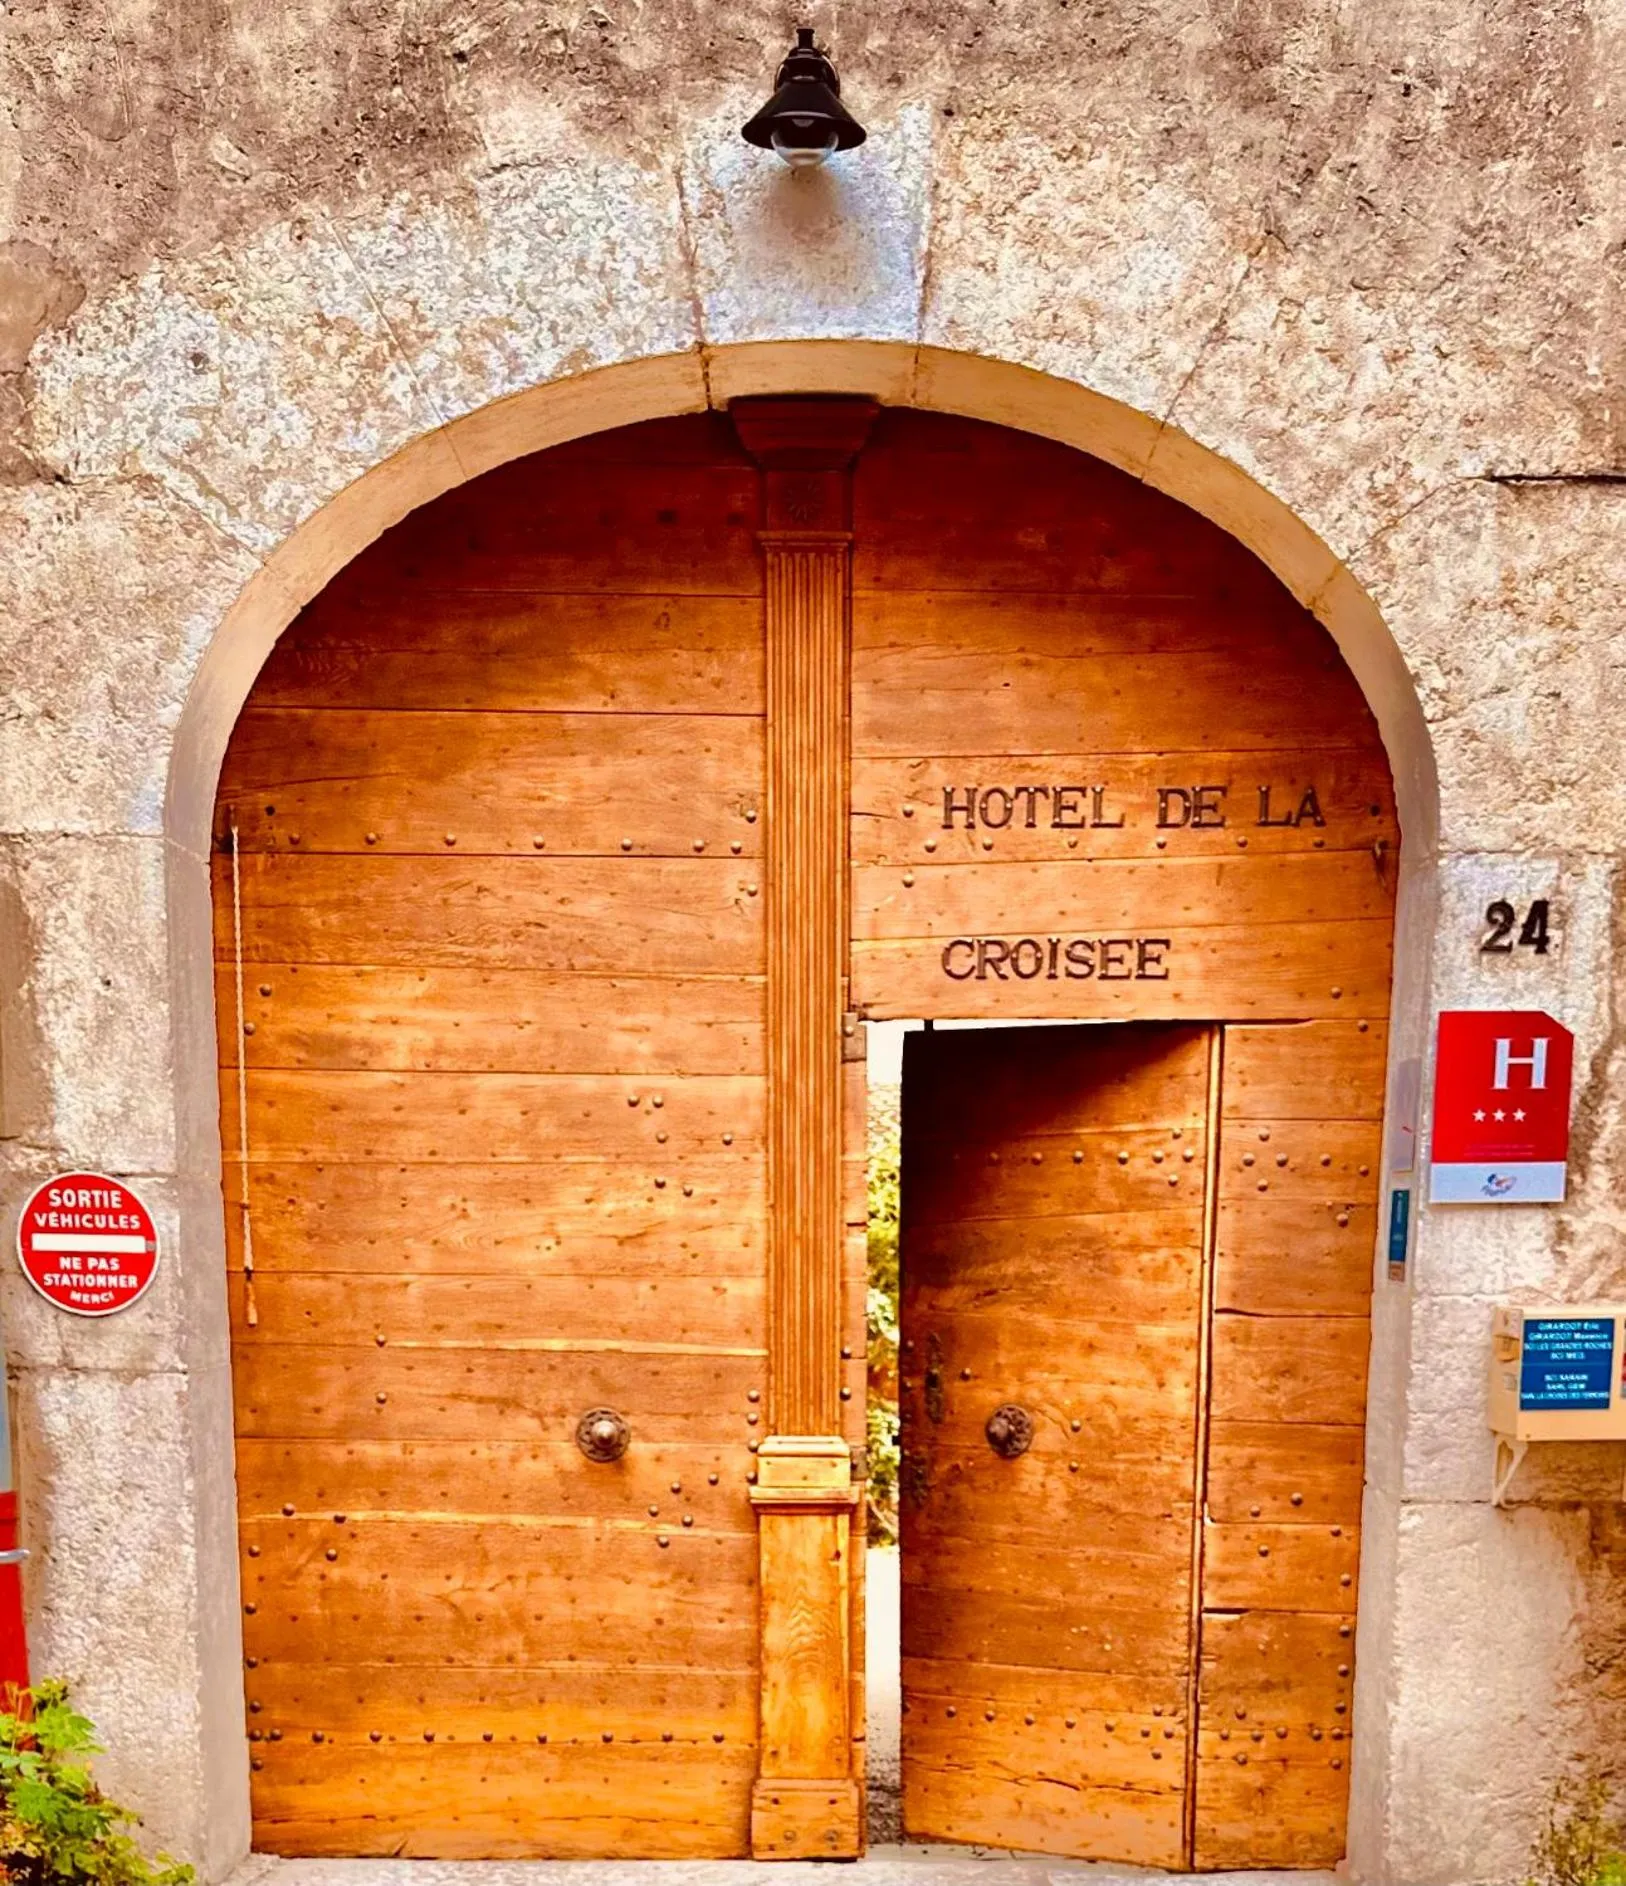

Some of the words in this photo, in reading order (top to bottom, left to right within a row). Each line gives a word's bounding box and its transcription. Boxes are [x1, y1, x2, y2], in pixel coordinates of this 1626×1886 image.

[941, 785, 1125, 830] HOTEL
[1156, 785, 1228, 830] DE
[1257, 785, 1327, 829] LA
[1480, 898, 1550, 954] 24
[941, 938, 1171, 981] CROISEE
[1490, 1037, 1551, 1089] H
[48, 1188, 122, 1209] SORTIE
[34, 1211, 141, 1230] VÉHICULES
[59, 1256, 82, 1270] NE
[87, 1257, 120, 1271] PAS
[43, 1273, 138, 1289] STATIONNER
